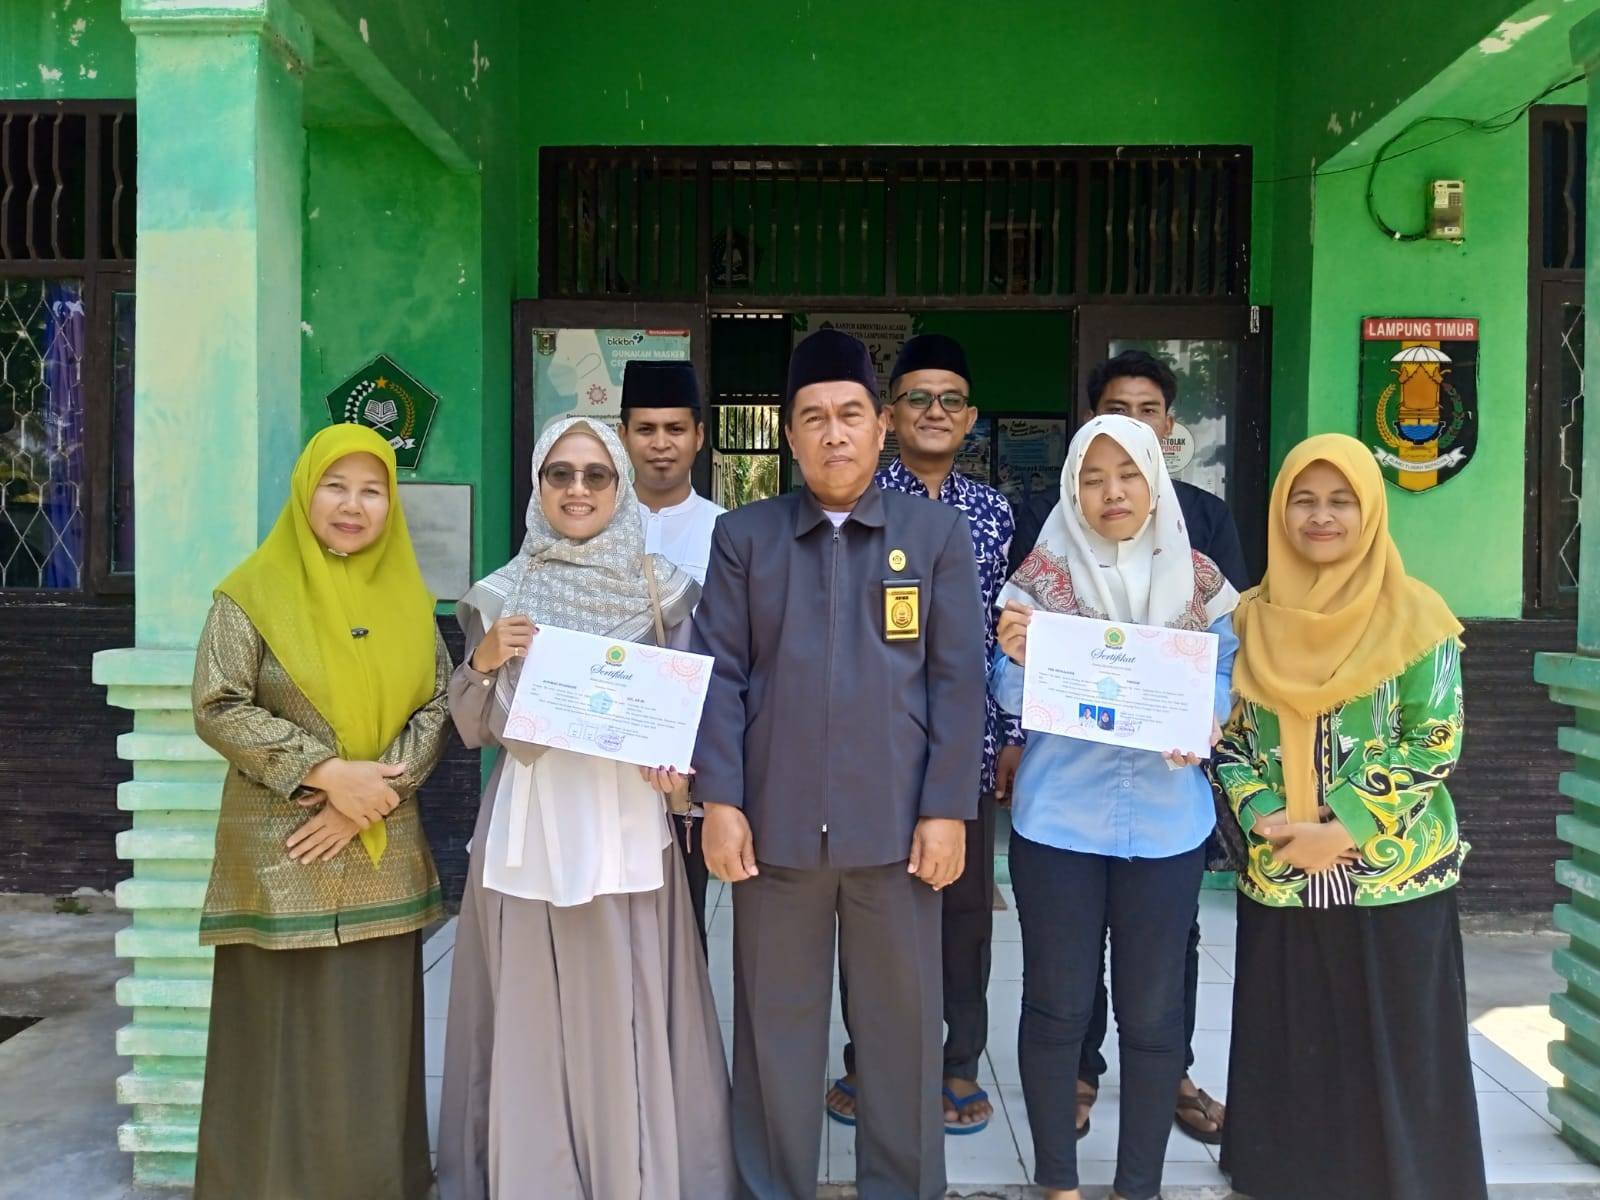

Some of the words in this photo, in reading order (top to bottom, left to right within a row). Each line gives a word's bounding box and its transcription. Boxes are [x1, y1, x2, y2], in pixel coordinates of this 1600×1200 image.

[1369, 322, 1432, 337] LAMPUNG
[1434, 322, 1474, 337] TIMUR
[607, 337, 635, 346] bkkbn
[655, 350, 685, 359] MASKER
[1166, 438, 1186, 446] TOLAK
[1090, 647, 1136, 665] Sertifikat
[590, 663, 634, 681] Sertifikat
